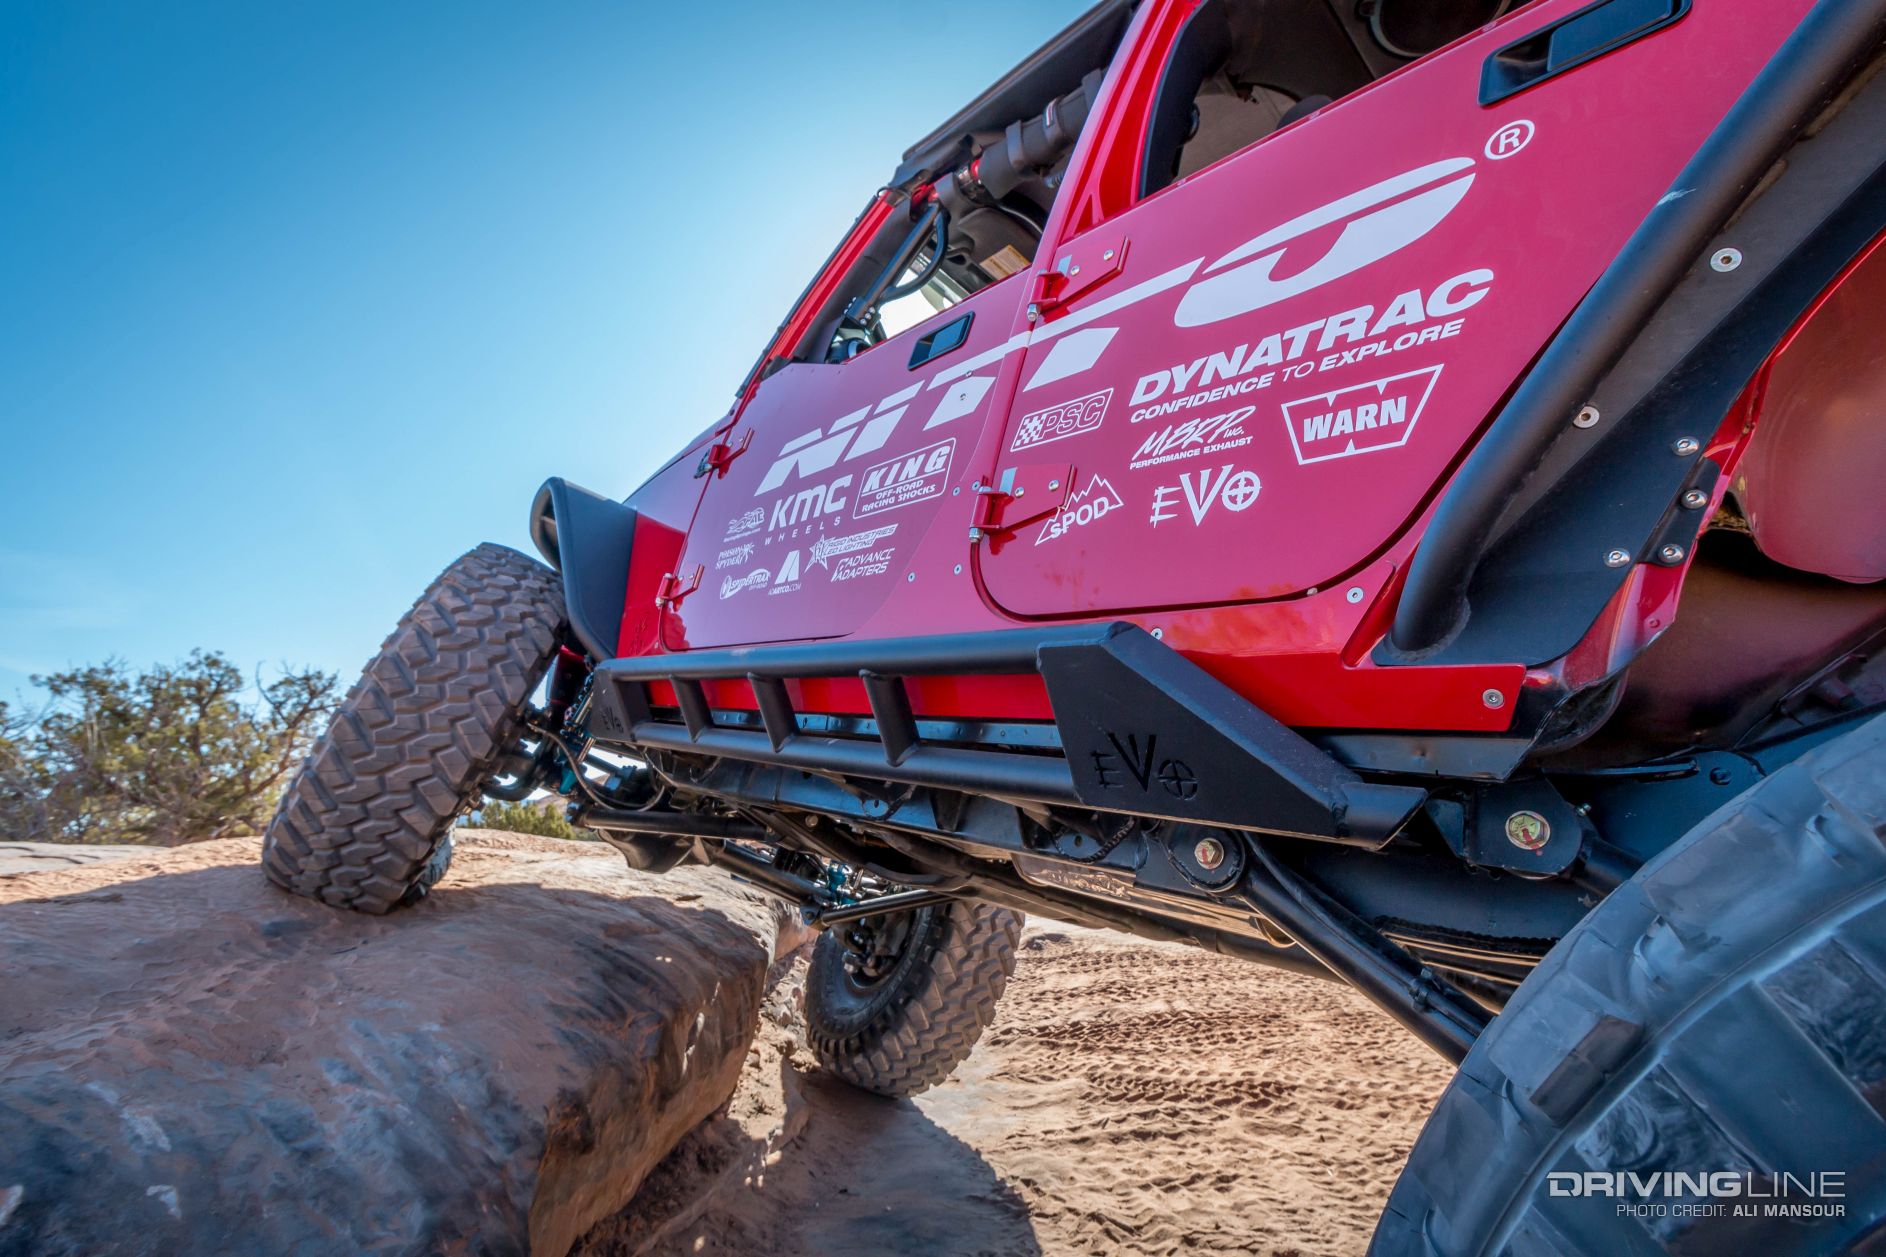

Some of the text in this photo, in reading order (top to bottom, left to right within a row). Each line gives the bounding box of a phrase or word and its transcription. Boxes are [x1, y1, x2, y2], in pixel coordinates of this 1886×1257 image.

[1129, 268, 1494, 408] DYNATRAC
[1130, 318, 1465, 424] CONFIDENCE TO EXPLORE
[1037, 395, 1105, 441] PSC
[1131, 405, 1257, 462] MBRP
[1303, 396, 1407, 443] WARN
[862, 445, 951, 494] KING
[1129, 436, 1253, 470] PERFORMANCE EXHAUST
[768, 474, 853, 532] KMC
[861, 484, 936, 513] RACING SHOCKS
[875, 479, 924, 501] OFF-ROAD
[764, 516, 841, 546] WHEELS
